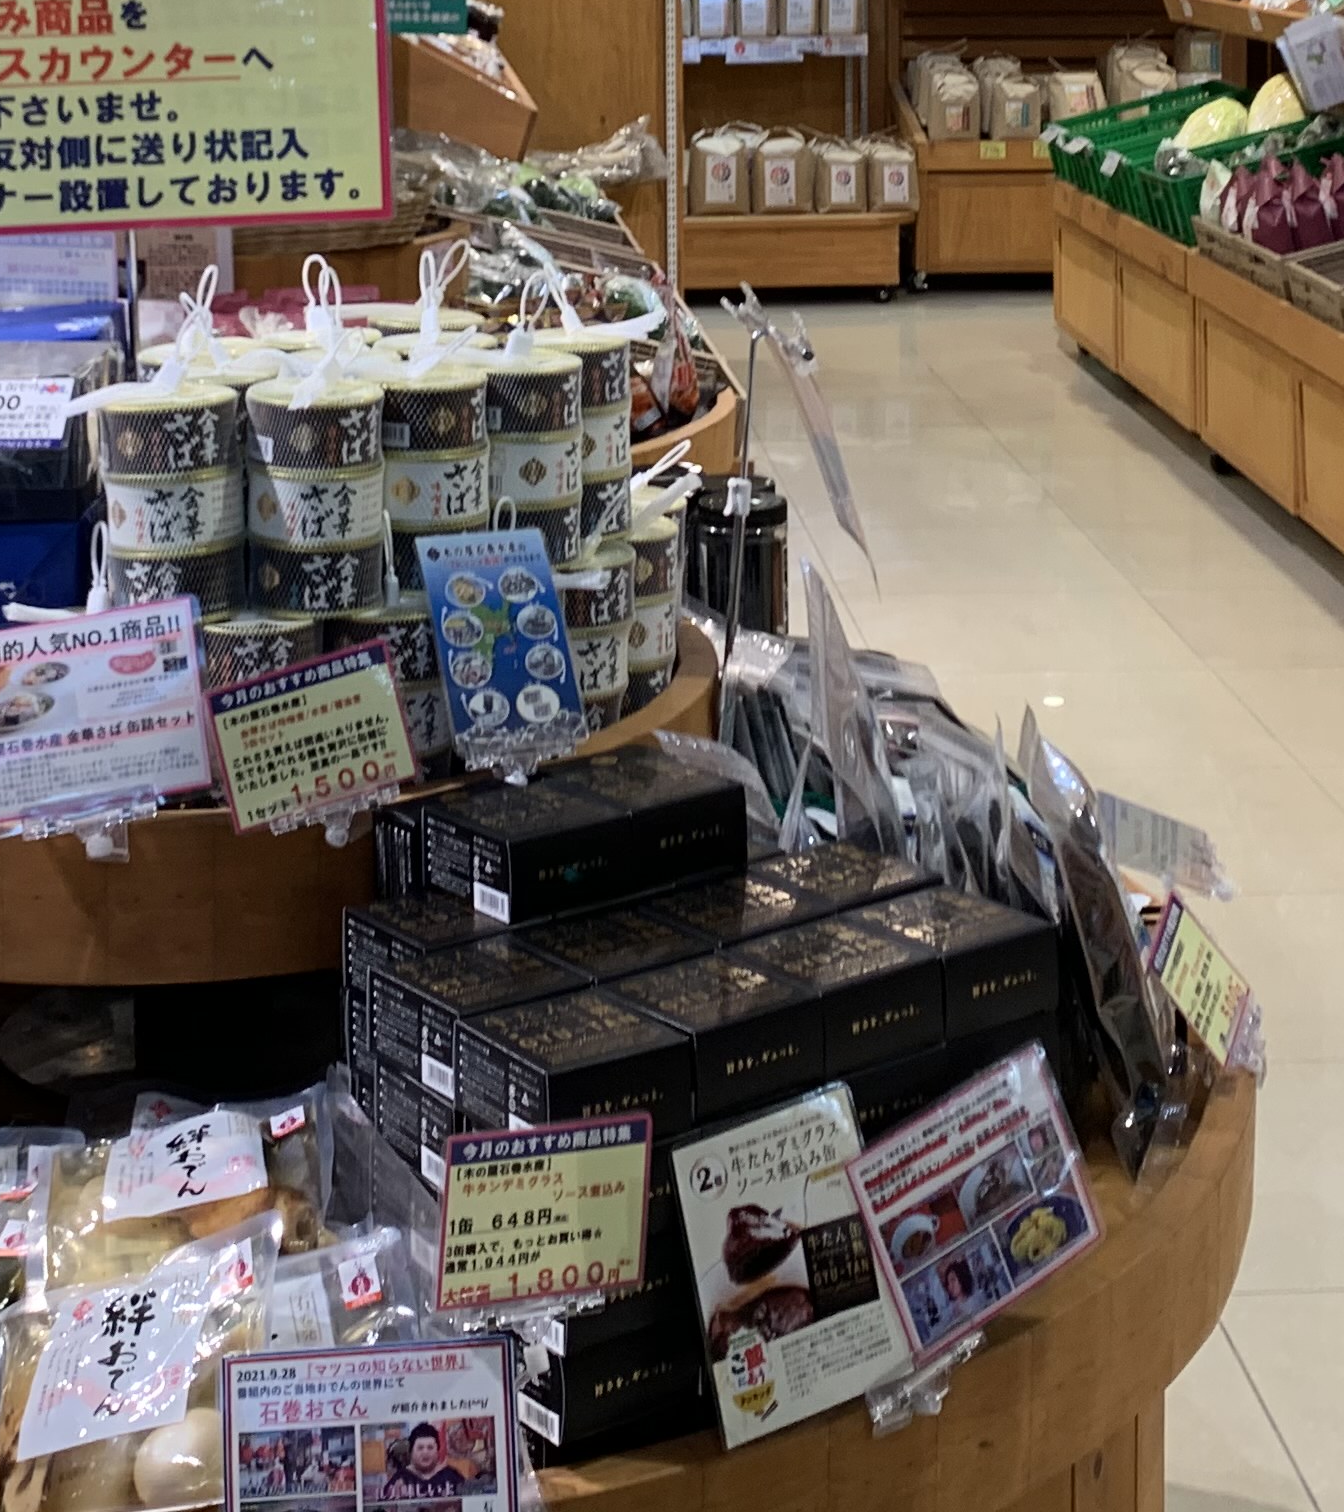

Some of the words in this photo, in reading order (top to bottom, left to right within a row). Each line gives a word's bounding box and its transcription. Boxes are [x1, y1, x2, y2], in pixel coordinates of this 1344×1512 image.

[220, 651, 373, 709] 今月のおすすめ商品特集
[290, 760, 398, 806] 1,500円
[462, 1123, 632, 1162] 今月のおすすめ商品特集
[491, 1208, 552, 1230] 648円
[93, 1290, 157, 1417] 絆おでん
[236, 1367, 297, 1383] 2021.9.28
[259, 1395, 370, 1425] 石巻おでん
